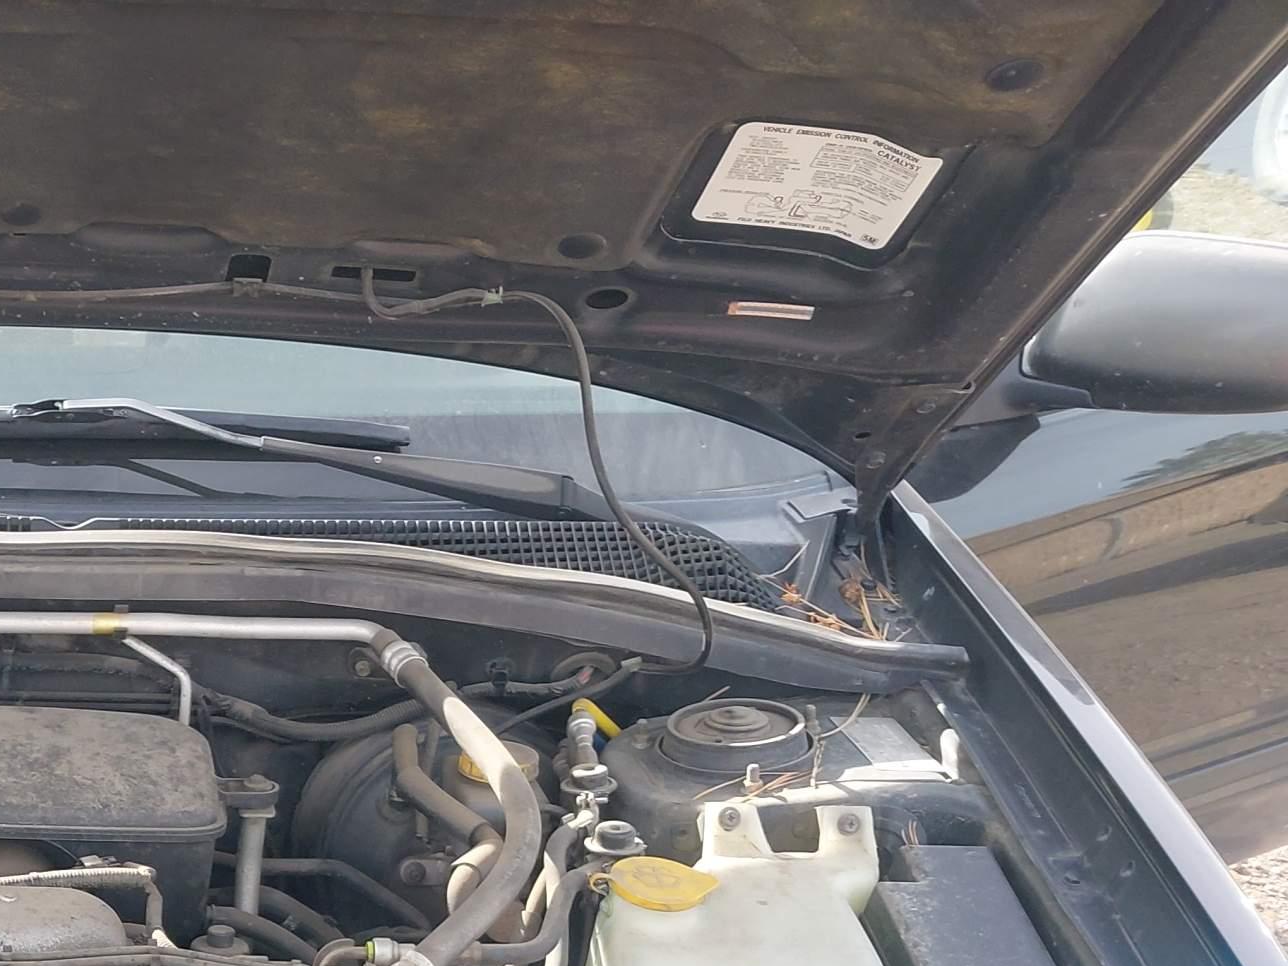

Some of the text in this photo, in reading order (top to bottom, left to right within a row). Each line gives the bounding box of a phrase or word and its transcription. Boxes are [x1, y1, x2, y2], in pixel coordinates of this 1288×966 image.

[763, 126, 793, 134] VEHICLE
[796, 129, 832, 139] EMISSION
[835, 133, 869, 143] CONTROL
[872, 139, 919, 163] INFORMATION
[877, 150, 922, 172] CATALYST
